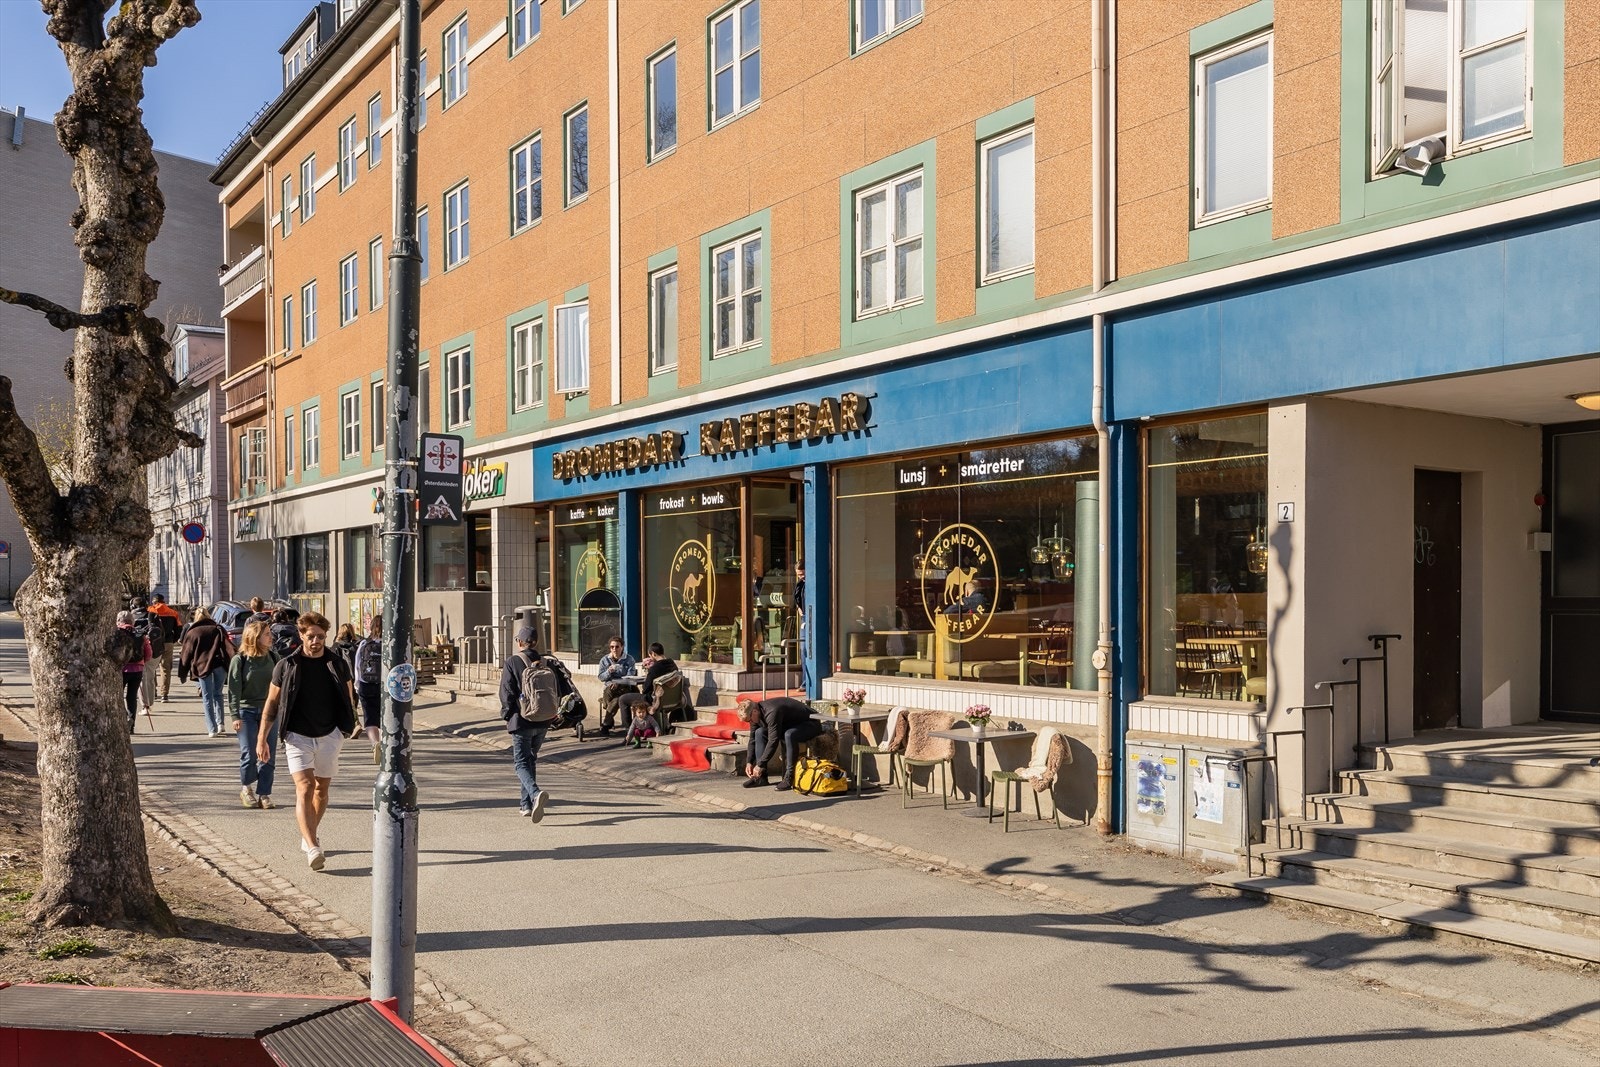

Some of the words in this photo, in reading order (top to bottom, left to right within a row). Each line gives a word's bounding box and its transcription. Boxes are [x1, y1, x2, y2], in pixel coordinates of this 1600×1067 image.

[552, 429, 681, 480] DROMEDAR
[700, 392, 868, 456] KAFFEBAR
[900, 467, 926, 486] lunsj
[961, 457, 1024, 477] småretter
[570, 508, 585, 520] kaffe
[597, 505, 615, 517] kaker
[659, 496, 685, 510] frokost
[702, 491, 724, 506] bowls
[1283, 505, 1289, 520] 2
[675, 547, 709, 572] DROMEDAR
[931, 533, 988, 566] DROMEDAR
[677, 603, 708, 625] KAFFEBAR
[933, 604, 985, 632] KFFEBAR
